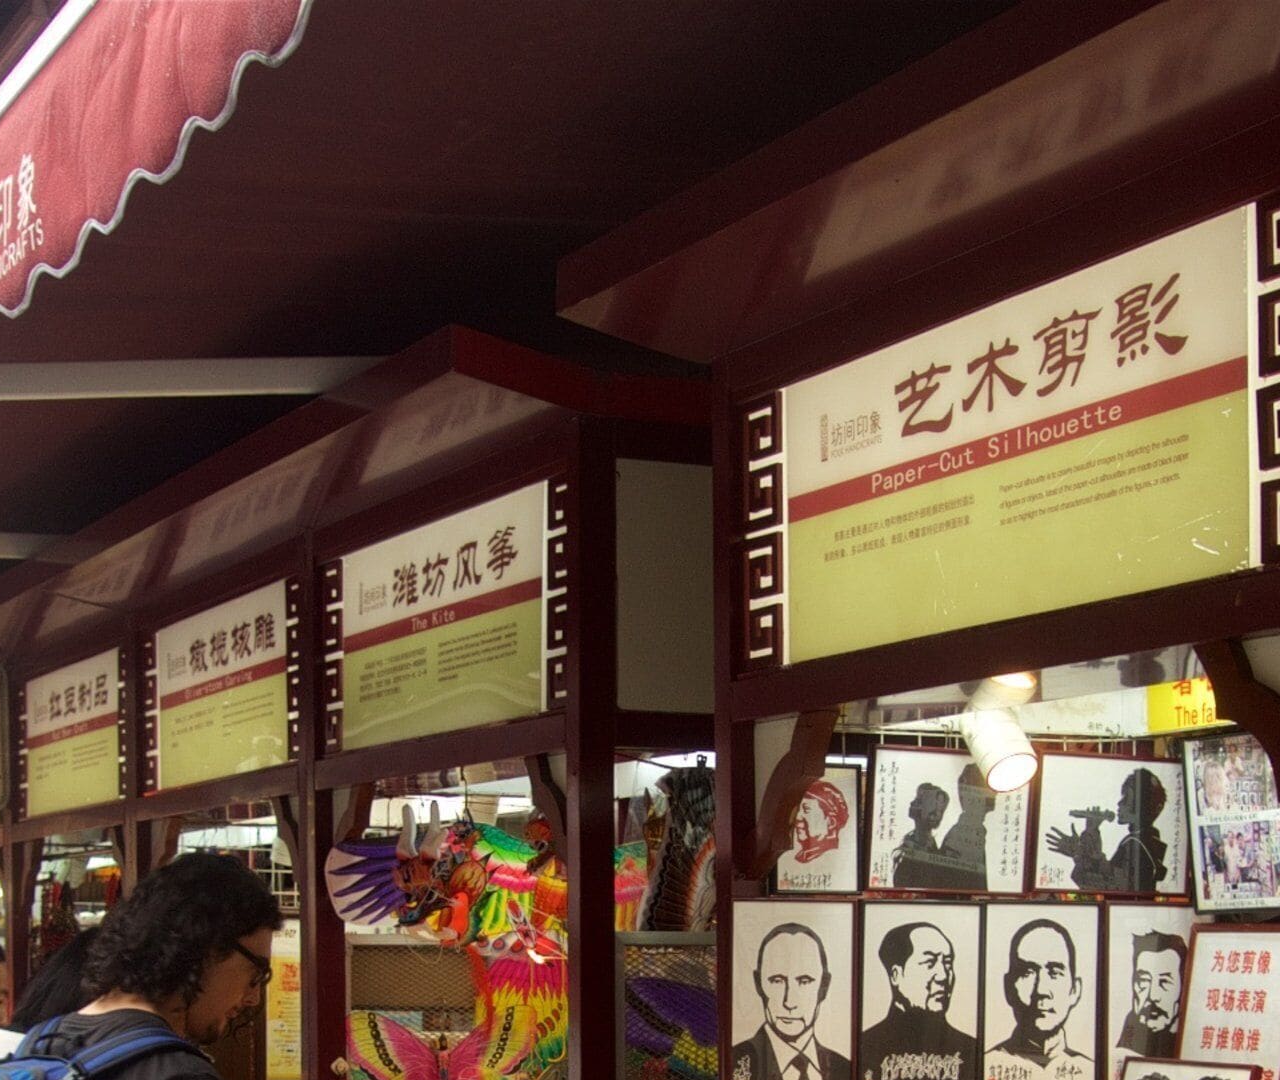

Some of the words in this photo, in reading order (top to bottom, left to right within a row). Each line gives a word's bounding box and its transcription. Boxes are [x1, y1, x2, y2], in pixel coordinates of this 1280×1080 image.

[894, 272, 1189, 439] 艺术剪影
[831, 410, 882, 447] 坊间印象
[871, 447, 974, 493] Paper-Cut
[988, 405, 1123, 459] Silhouette
[392, 526, 519, 608] 潍坊风筝
[411, 616, 427, 632] The
[431, 609, 455, 627] Kite
[1175, 706, 1198, 727] The
[1211, 950, 1271, 974] 为您剪像
[1206, 988, 1267, 1013] 现场表演
[1200, 1025, 1261, 1051] 剪谁像谁
